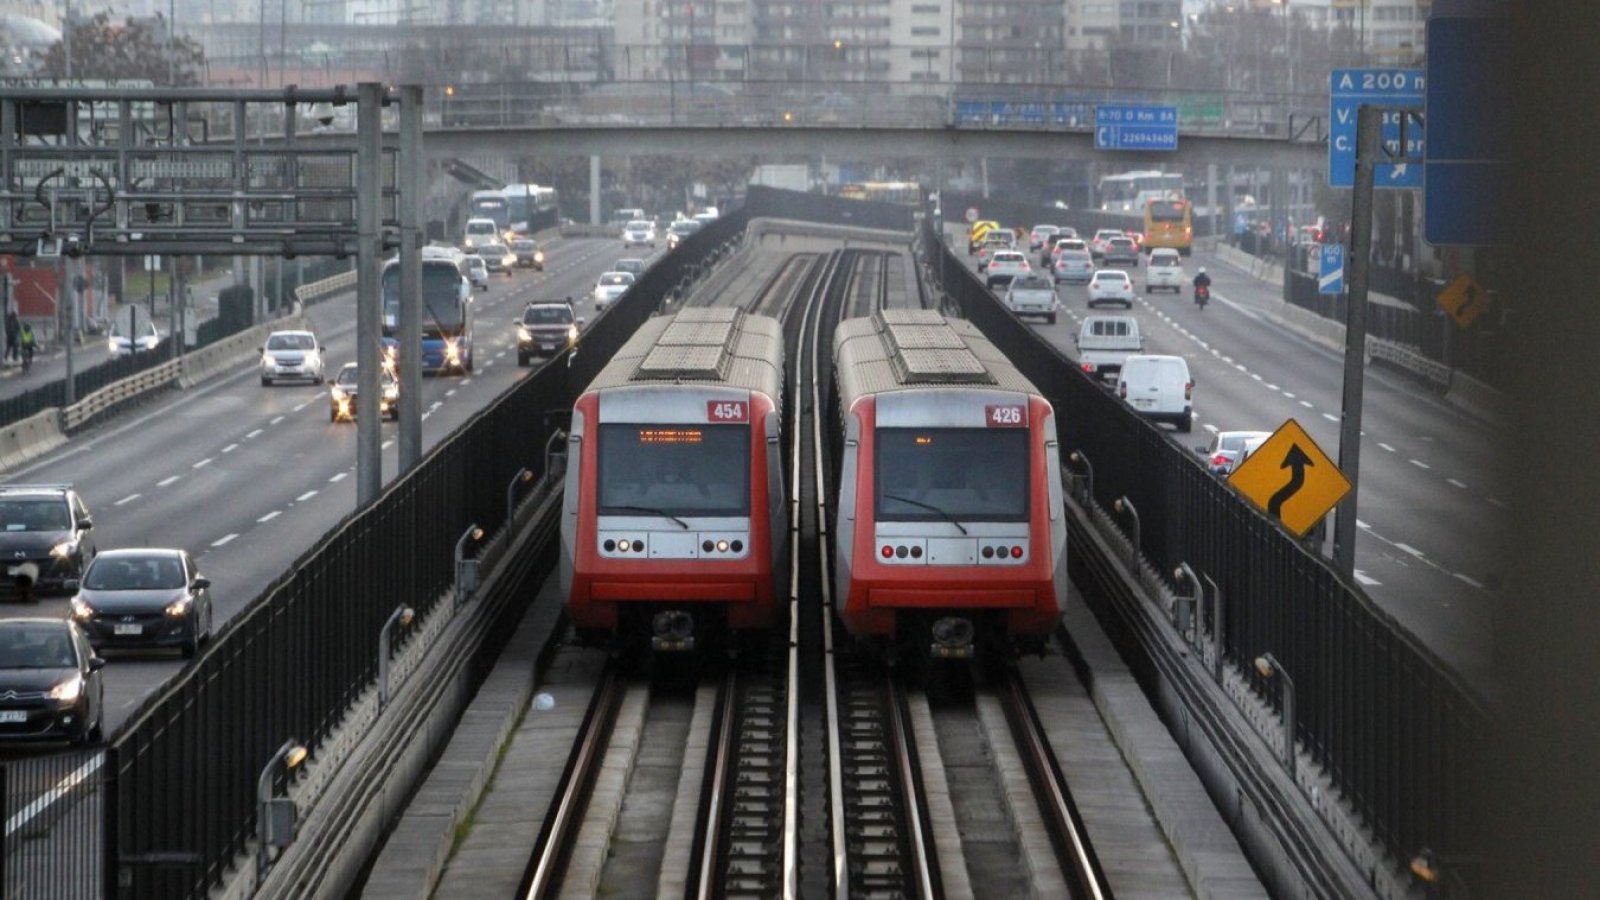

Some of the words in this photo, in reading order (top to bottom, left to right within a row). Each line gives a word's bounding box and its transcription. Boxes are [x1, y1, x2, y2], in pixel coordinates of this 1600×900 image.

[1340, 73, 1353, 89] A
[1362, 73, 1406, 89] 200
[1137, 110, 1155, 121] Km
[1337, 108, 1353, 124] V.
[1336, 136, 1352, 151] C.
[714, 403, 742, 419] 454
[992, 407, 1021, 424] 426
